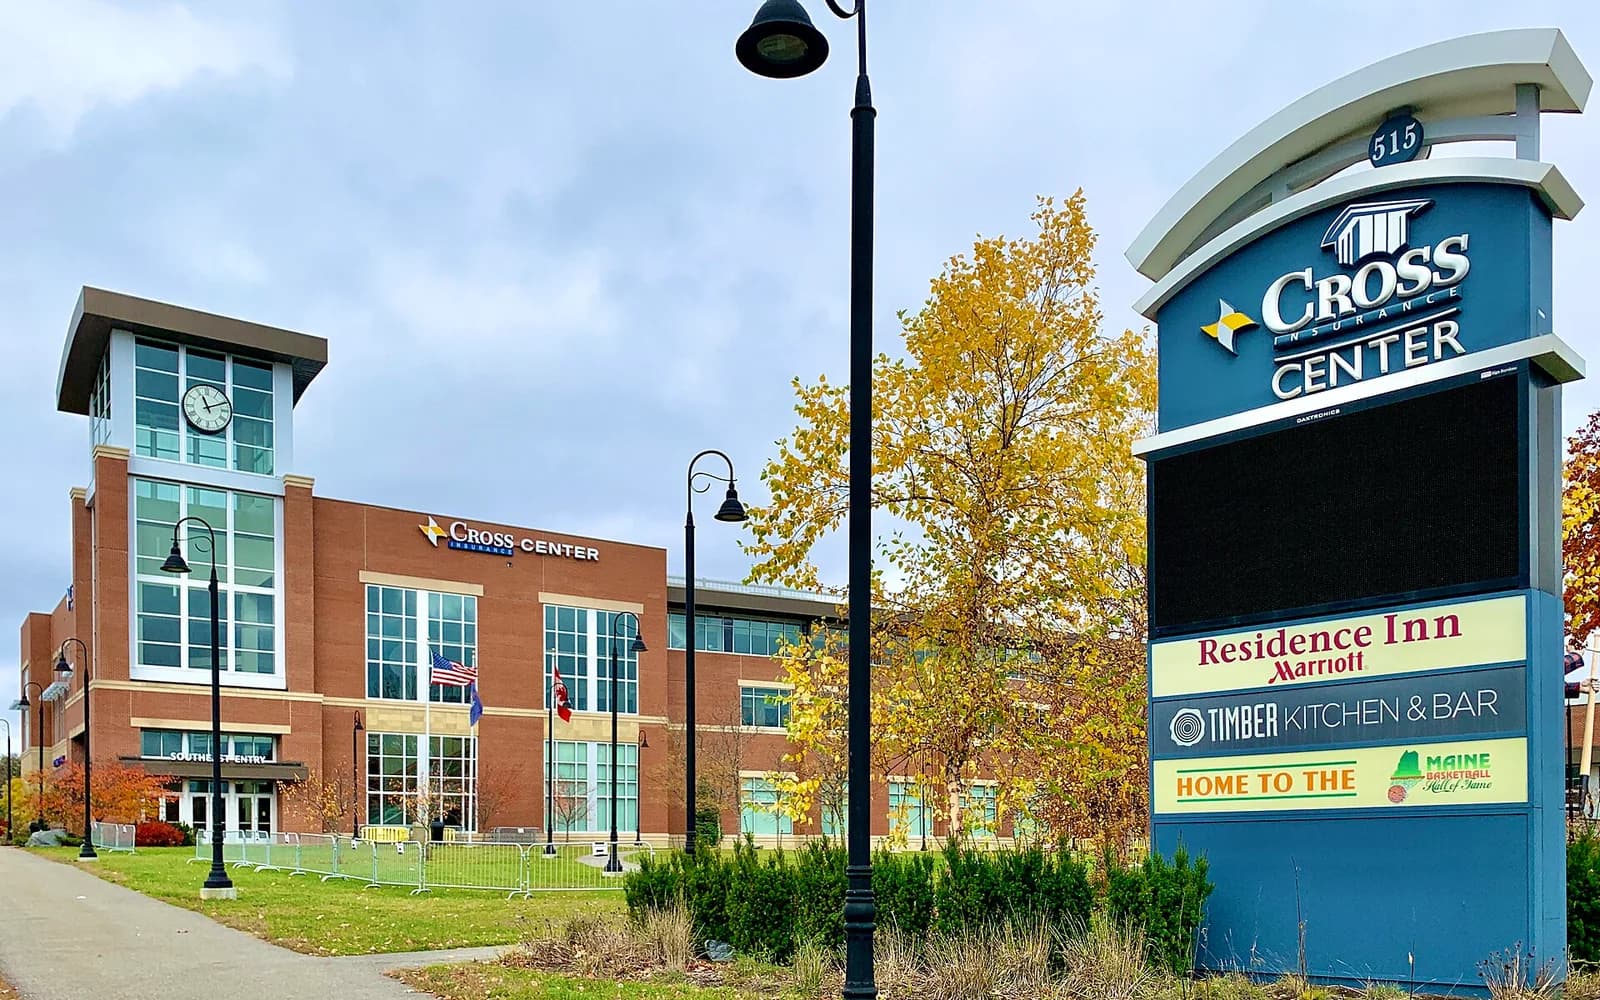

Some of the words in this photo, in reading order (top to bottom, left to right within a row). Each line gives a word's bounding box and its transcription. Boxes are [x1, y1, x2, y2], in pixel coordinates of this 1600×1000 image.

[1372, 122, 1416, 161] 515
[1261, 233, 1472, 334] CROSS
[1274, 287, 1458, 346] INSURANCE
[1271, 320, 1466, 400] CENTER
[1296, 408, 1340, 424] DAKTRONICS
[450, 521, 514, 548] CROSS
[520, 538, 600, 561] CENTER
[450, 541, 513, 556] INSURANCE
[1198, 623, 1373, 666] Residence
[1383, 613, 1463, 645] Inn
[1267, 651, 1365, 684] Marriott
[1208, 702, 1278, 742] TIMBER
[1284, 698, 1399, 731] KITCHEN
[1406, 694, 1428, 722] &
[1433, 689, 1498, 720] BAR
[170, 752, 229, 763] SOUTHEST
[235, 755, 266, 764] ENTRY
[1426, 753, 1491, 771] MAINE
[1426, 769, 1491, 780] BASKETBALL
[1177, 774, 1249, 796] HOME
[1257, 772, 1294, 794] TO
[1303, 769, 1356, 791] THE
[1422, 779, 1450, 793] Hall
[1461, 779, 1492, 790] Fame
